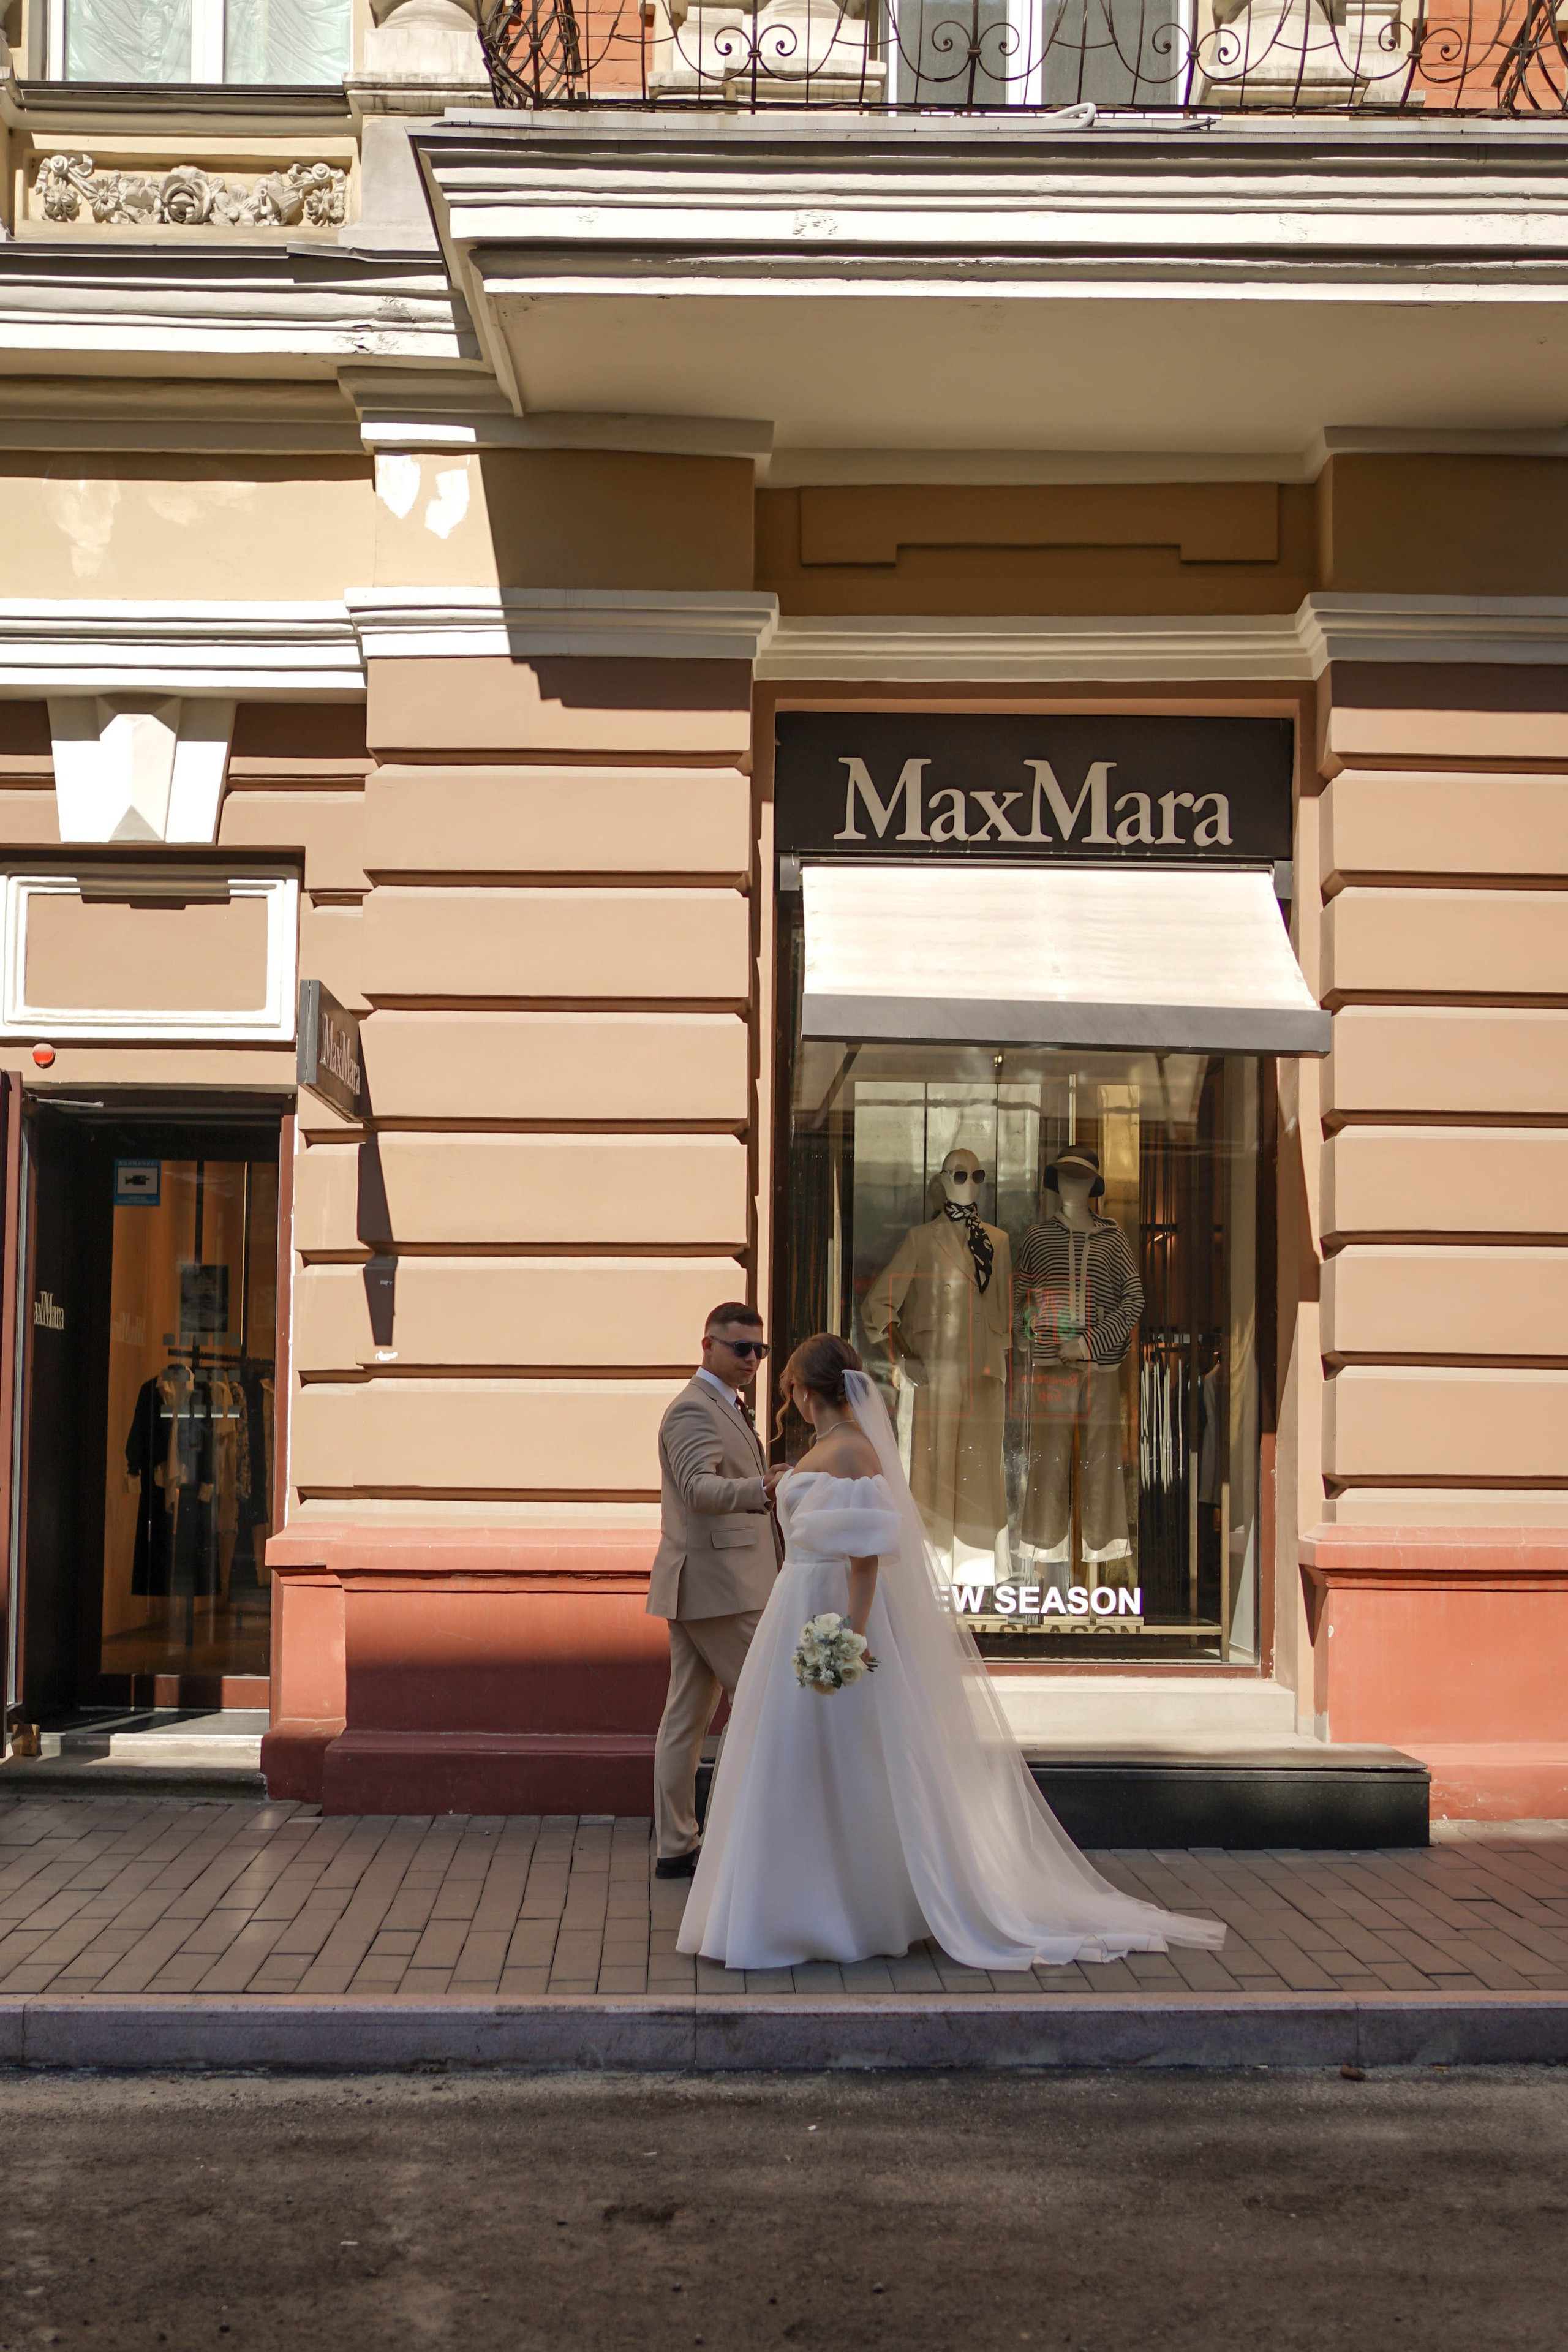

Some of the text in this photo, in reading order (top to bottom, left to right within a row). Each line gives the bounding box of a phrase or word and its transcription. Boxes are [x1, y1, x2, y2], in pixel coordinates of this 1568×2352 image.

[833, 756, 1234, 846] MaxMara
[320, 1013, 360, 1095] MaxMara
[34, 1291, 64, 1330] axMara
[937, 1585, 1142, 1614] EW SEASON
